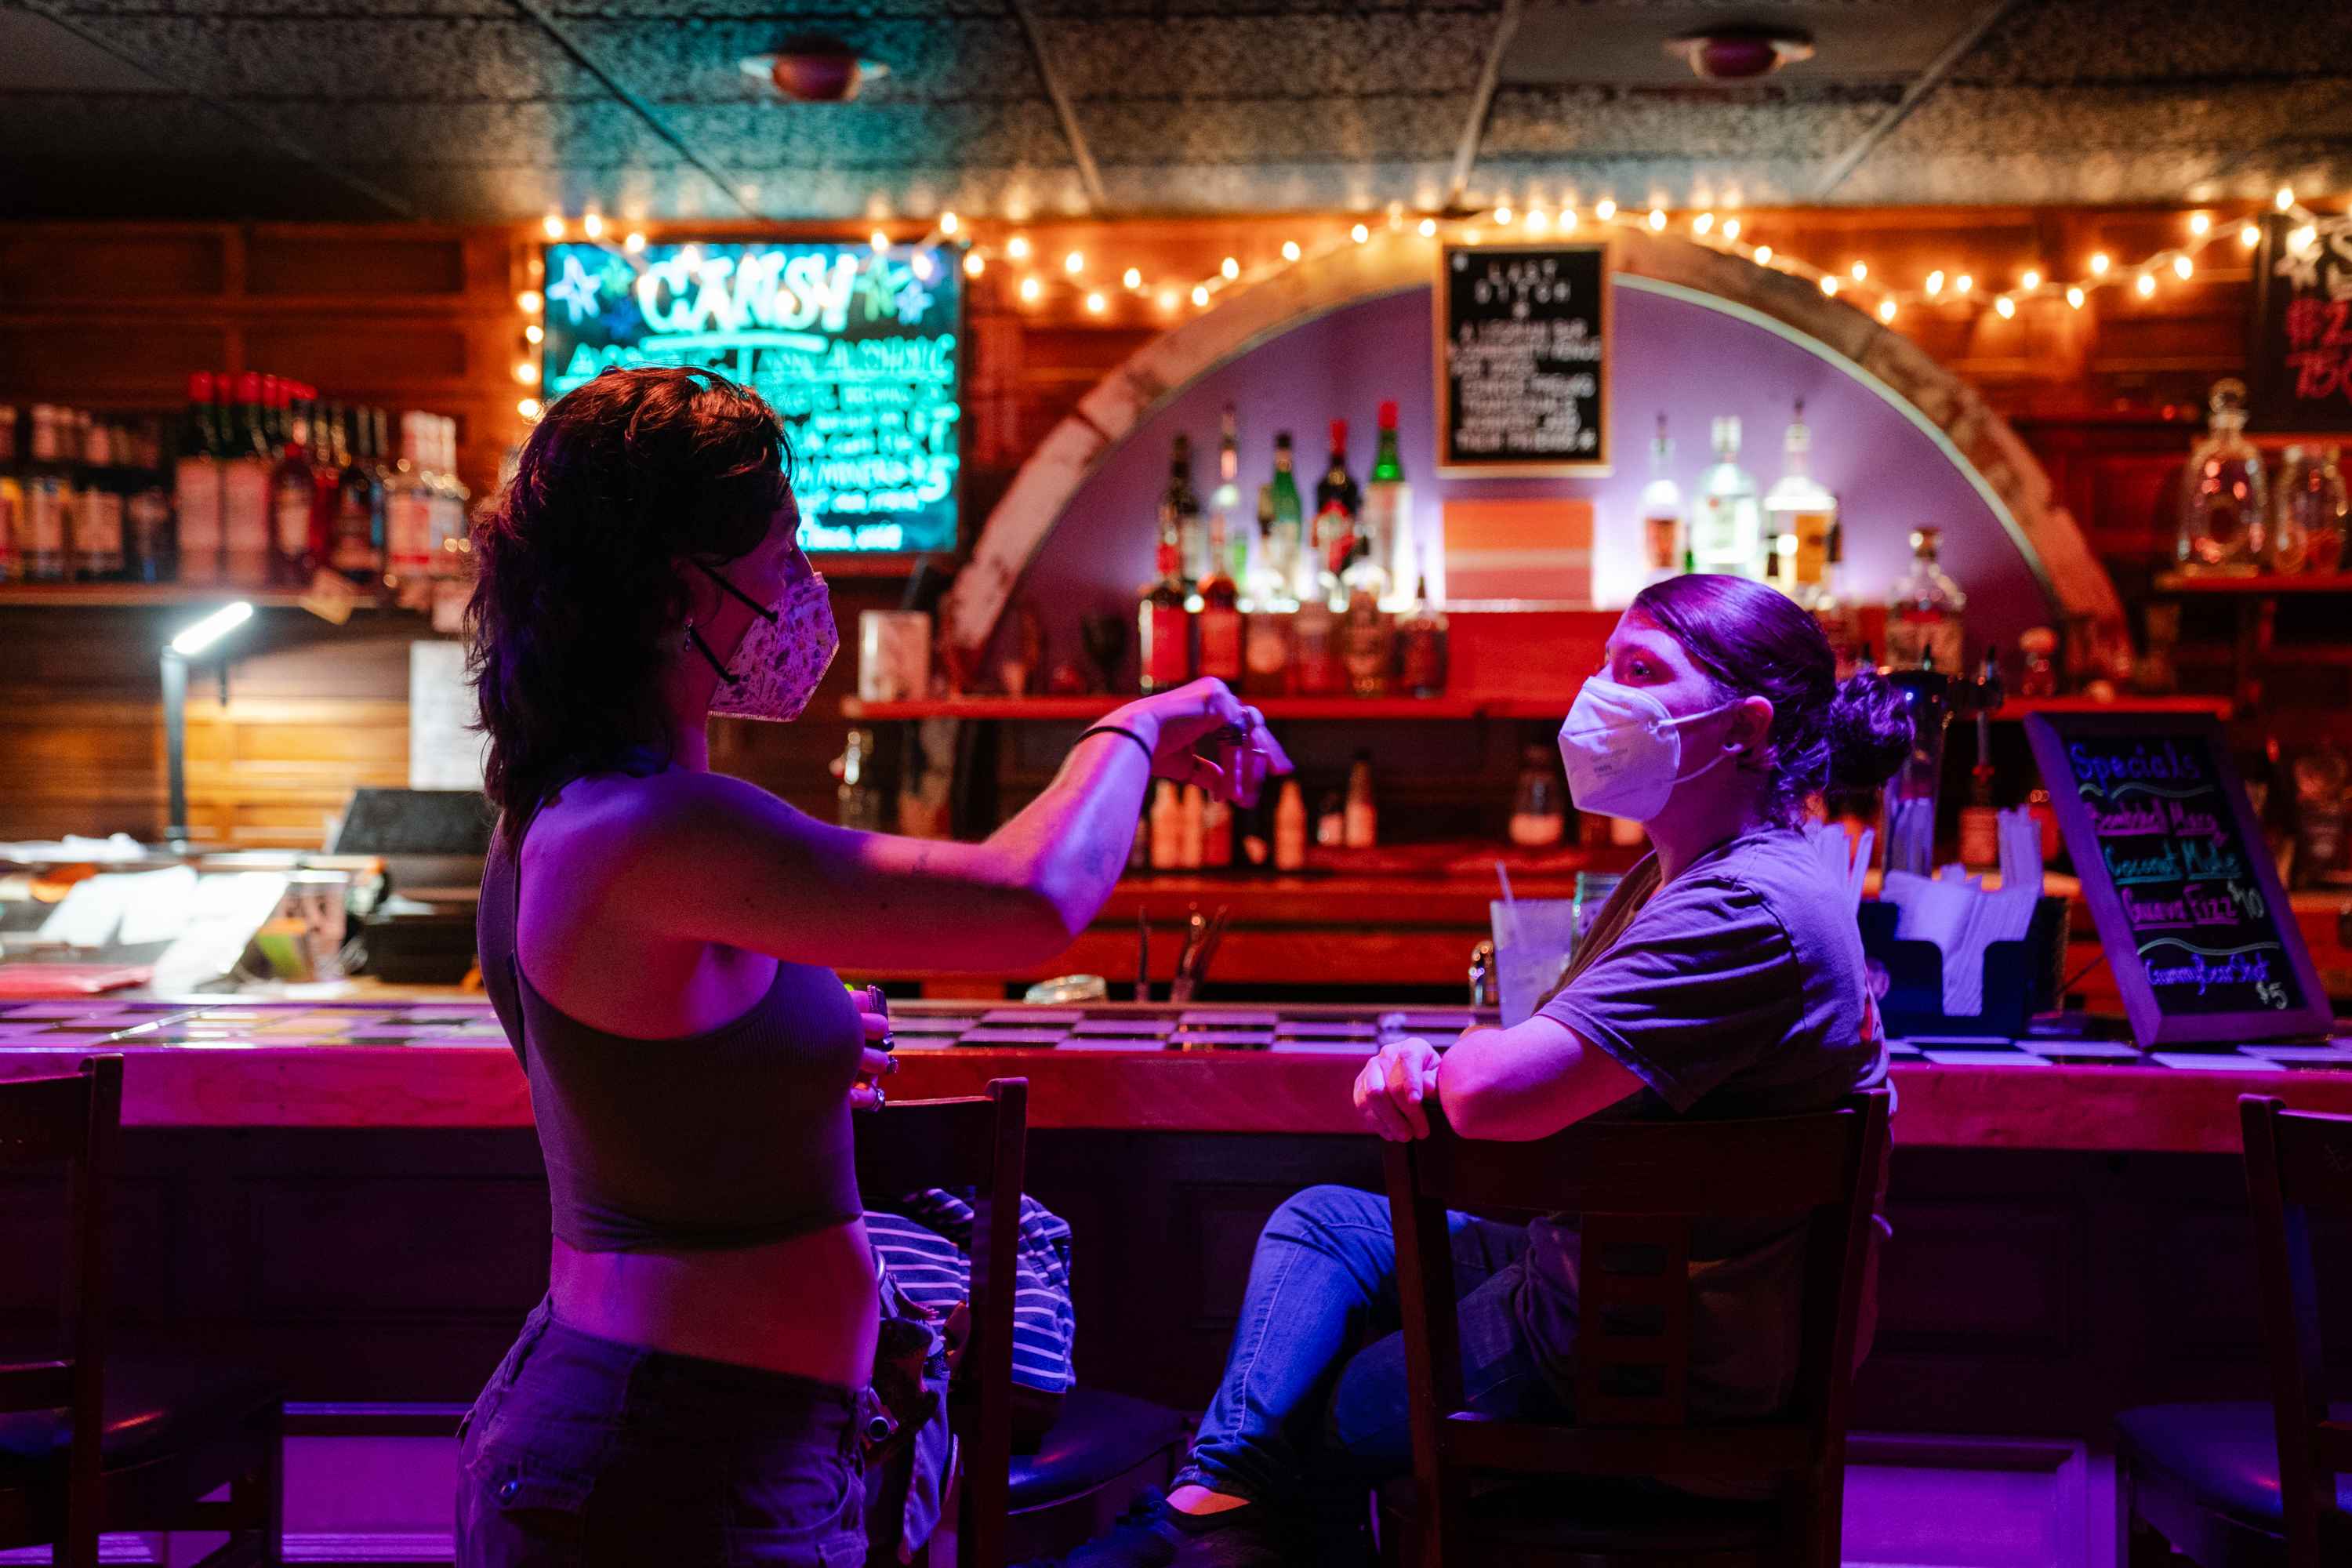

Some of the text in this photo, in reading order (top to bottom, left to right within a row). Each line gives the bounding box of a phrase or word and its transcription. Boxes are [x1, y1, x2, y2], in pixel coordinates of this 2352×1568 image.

[2071, 741, 2201, 797] Specials
[2183, 884, 2240, 920] Fizz
[2256, 982, 2288, 1010] $5
